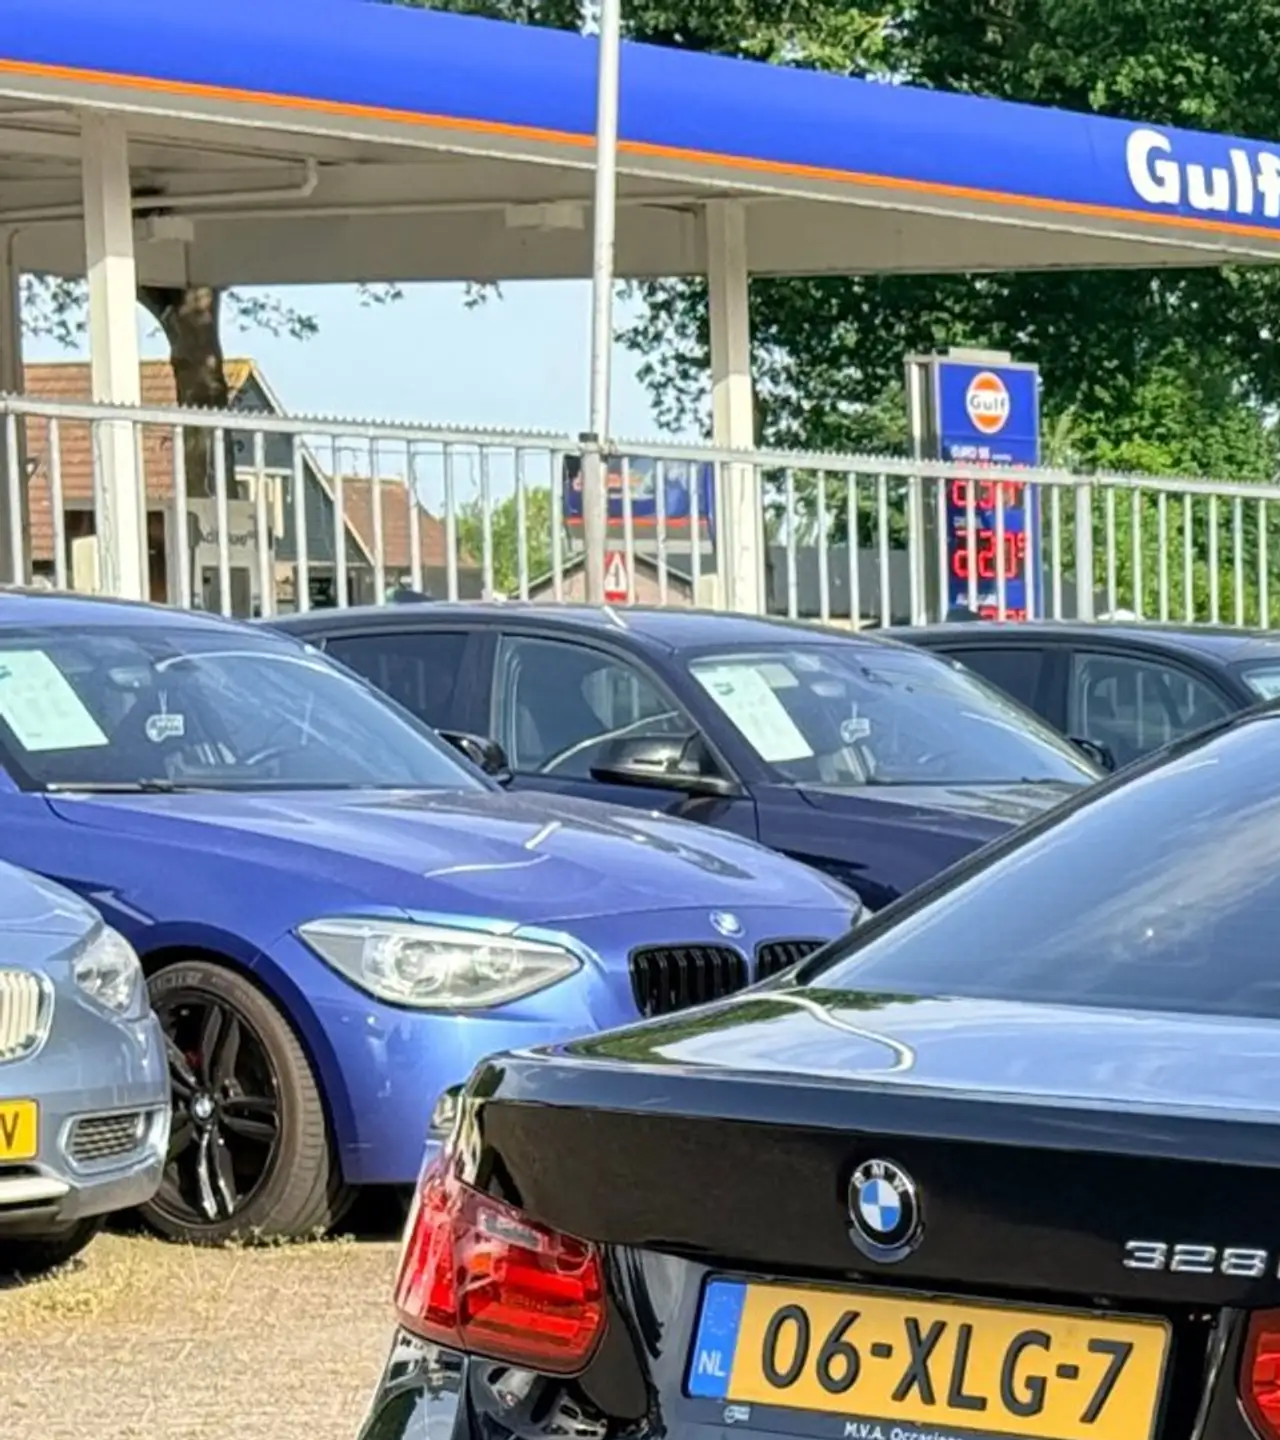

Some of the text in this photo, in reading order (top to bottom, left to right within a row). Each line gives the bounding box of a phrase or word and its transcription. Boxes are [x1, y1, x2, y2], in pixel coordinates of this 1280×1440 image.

[969, 394, 1006, 413] Gulf
[698, 1348, 728, 1378] NL
[761, 1303, 1135, 1424] 06-XLG-7
